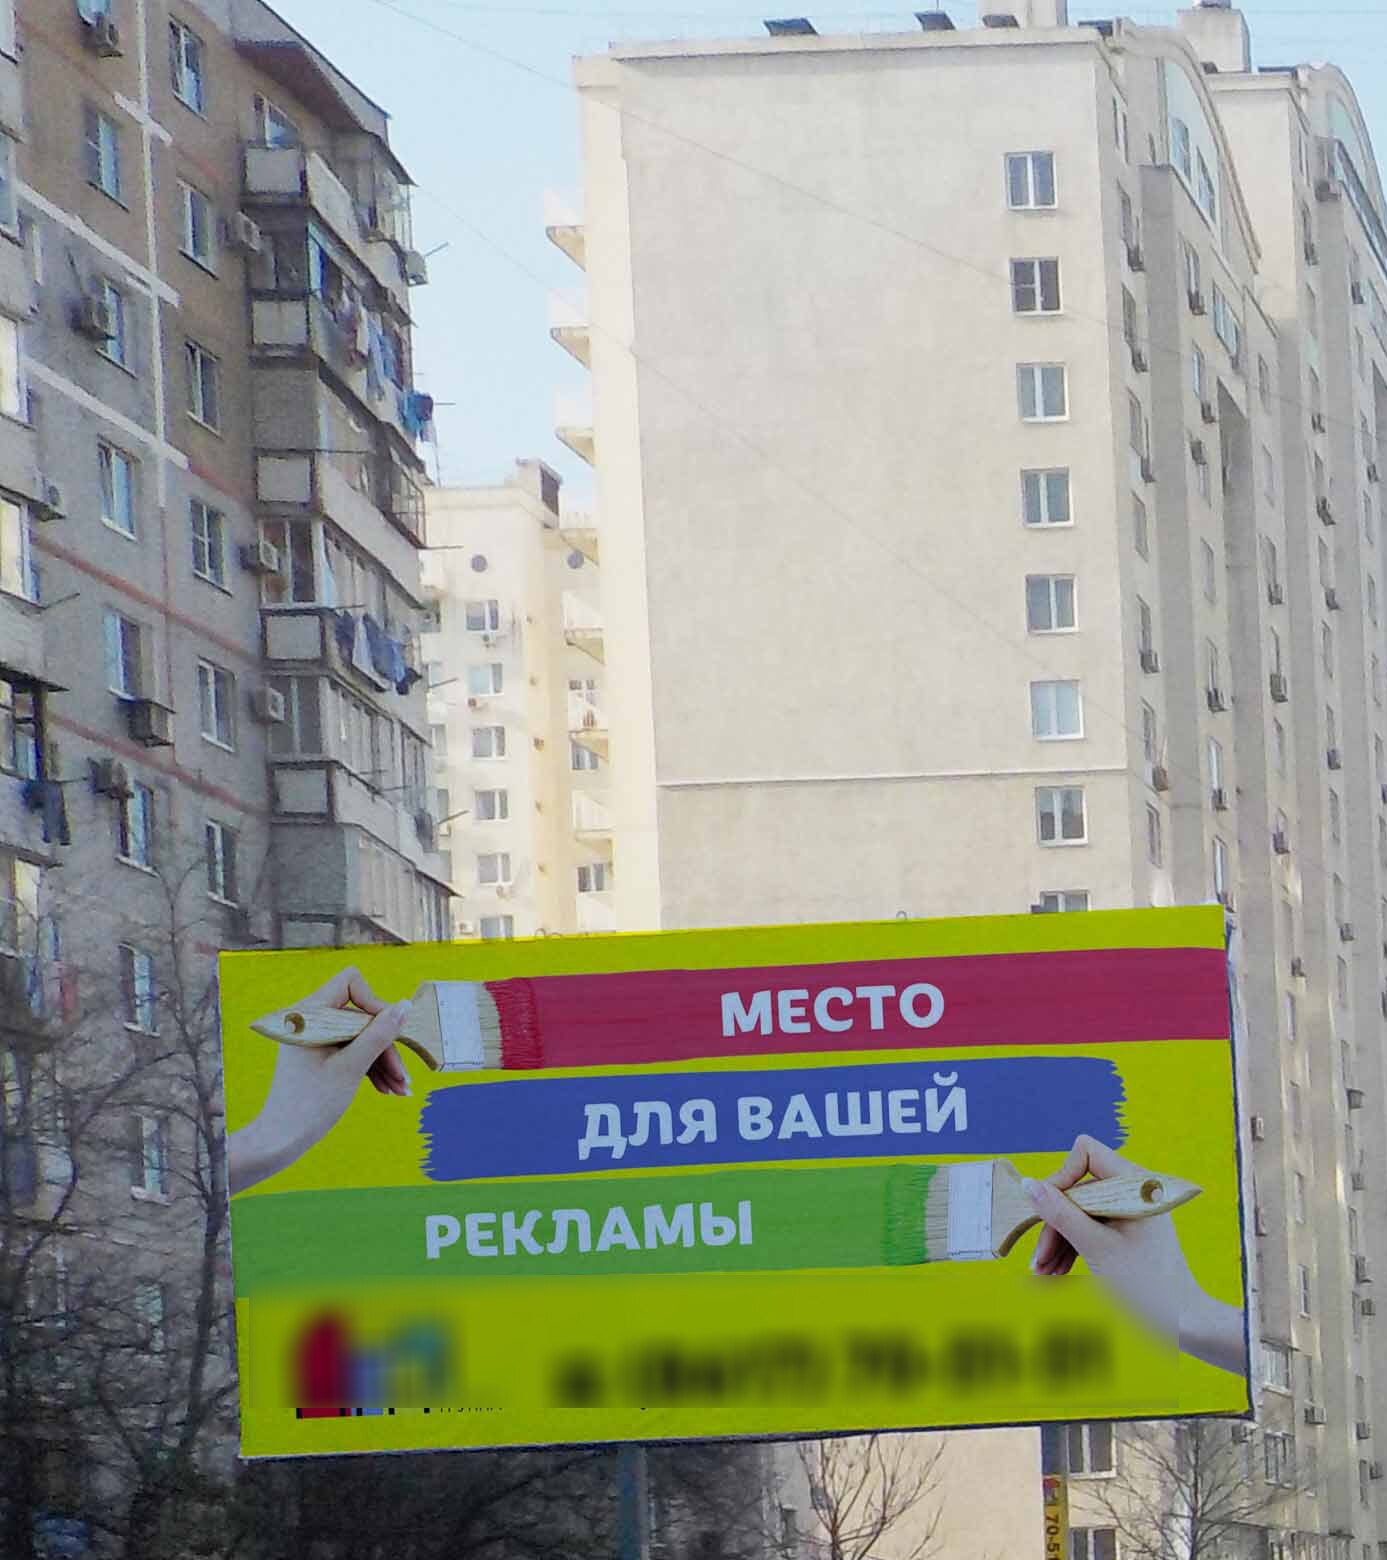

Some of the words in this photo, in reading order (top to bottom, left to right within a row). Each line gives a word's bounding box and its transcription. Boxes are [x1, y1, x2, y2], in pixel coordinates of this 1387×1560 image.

[720, 982, 946, 1038] МЕСТО
[577, 1099, 718, 1161] ДЛЯ
[736, 1071, 969, 1141] ВАШЕЙ
[425, 1200, 753, 1260] РЕКЛАМЫ
